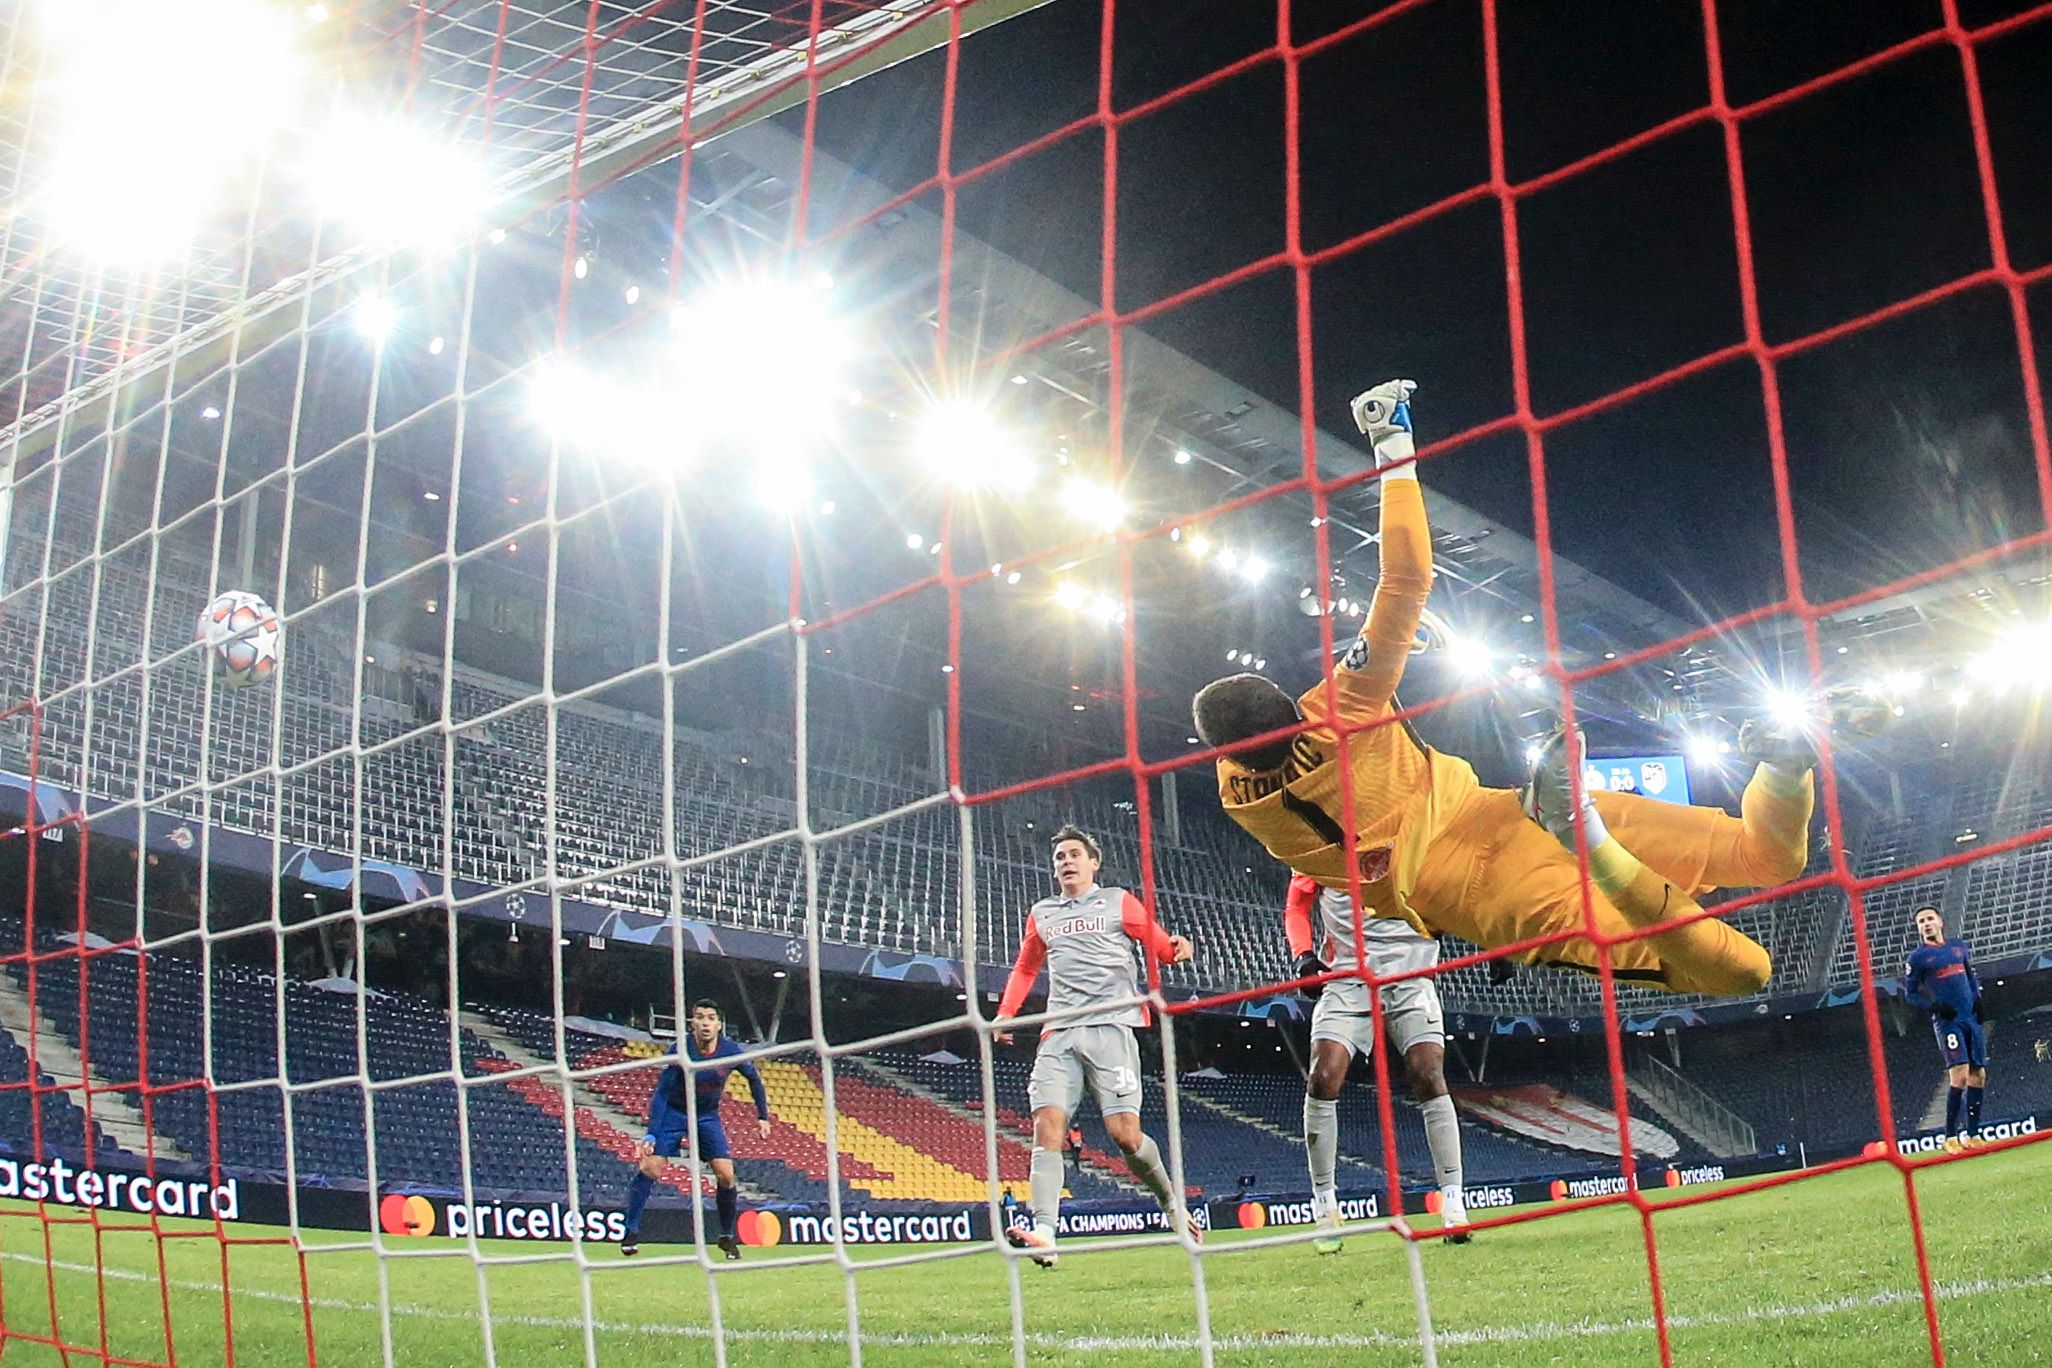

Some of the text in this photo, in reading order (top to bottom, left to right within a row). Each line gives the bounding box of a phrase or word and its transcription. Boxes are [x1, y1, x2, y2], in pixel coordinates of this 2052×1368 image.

[1045, 916, 1106, 940] Red Bull
[1947, 1033, 1959, 1050] 8
[1897, 1116, 2036, 1155] masecard
[1681, 1165, 1724, 1186] priceless
[1461, 1186, 1514, 1208] iceless
[446, 1200, 625, 1241] priceless
[1269, 1194, 1378, 1225] mastcard
[789, 1210, 971, 1243] mastercard
[1070, 1212, 1145, 1232] CHAMPIONS
